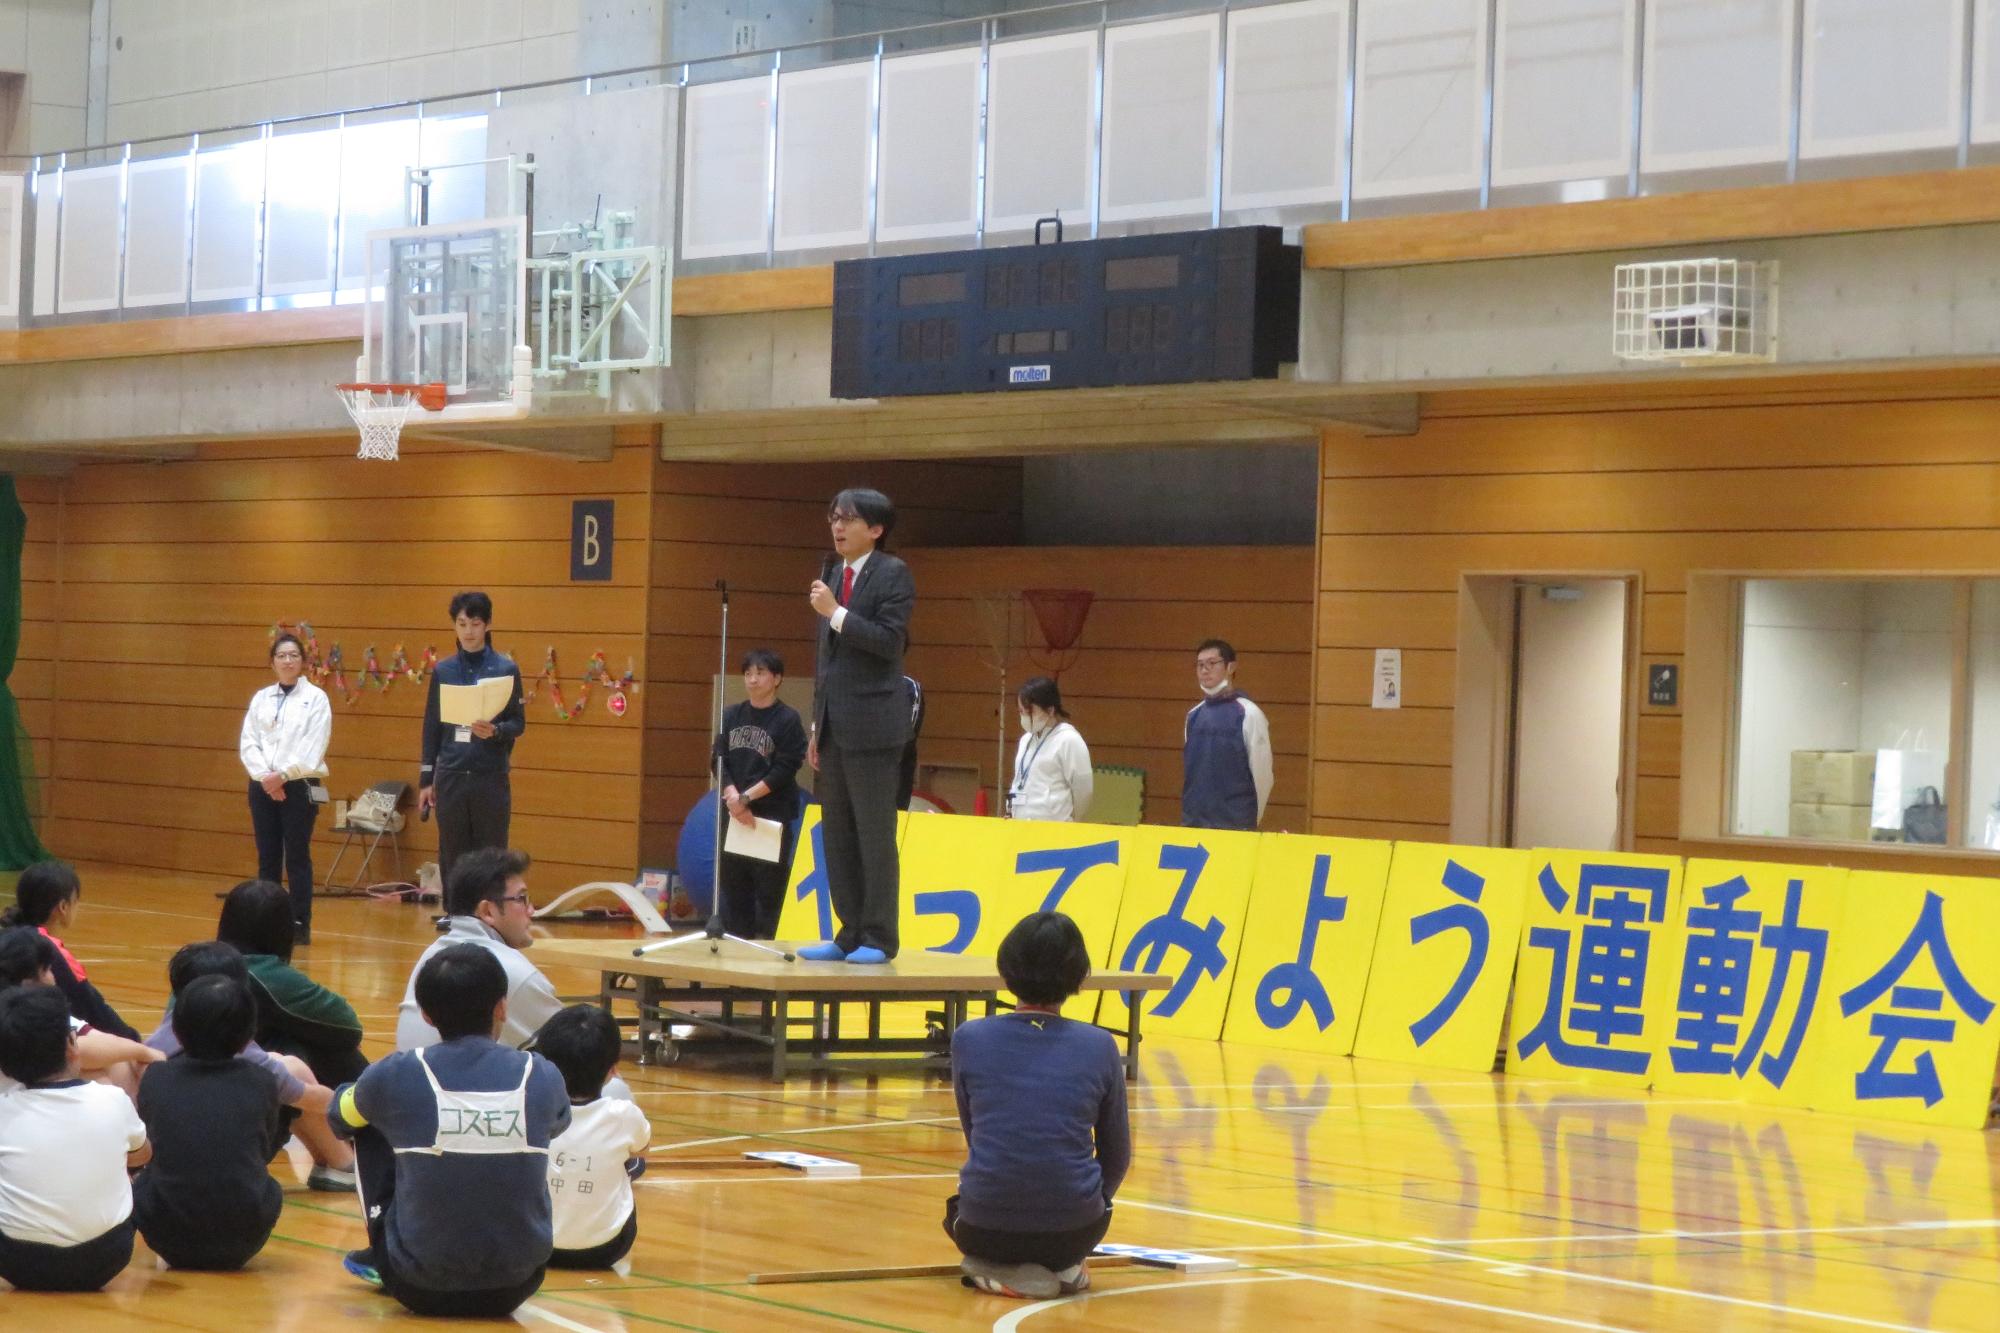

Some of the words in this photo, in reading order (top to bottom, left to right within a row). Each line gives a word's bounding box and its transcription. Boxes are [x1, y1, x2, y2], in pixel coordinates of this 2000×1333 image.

[1013, 367, 1047, 381] molten
[583, 514, 600, 566] B
[440, 1108, 523, 1137] コスモス
